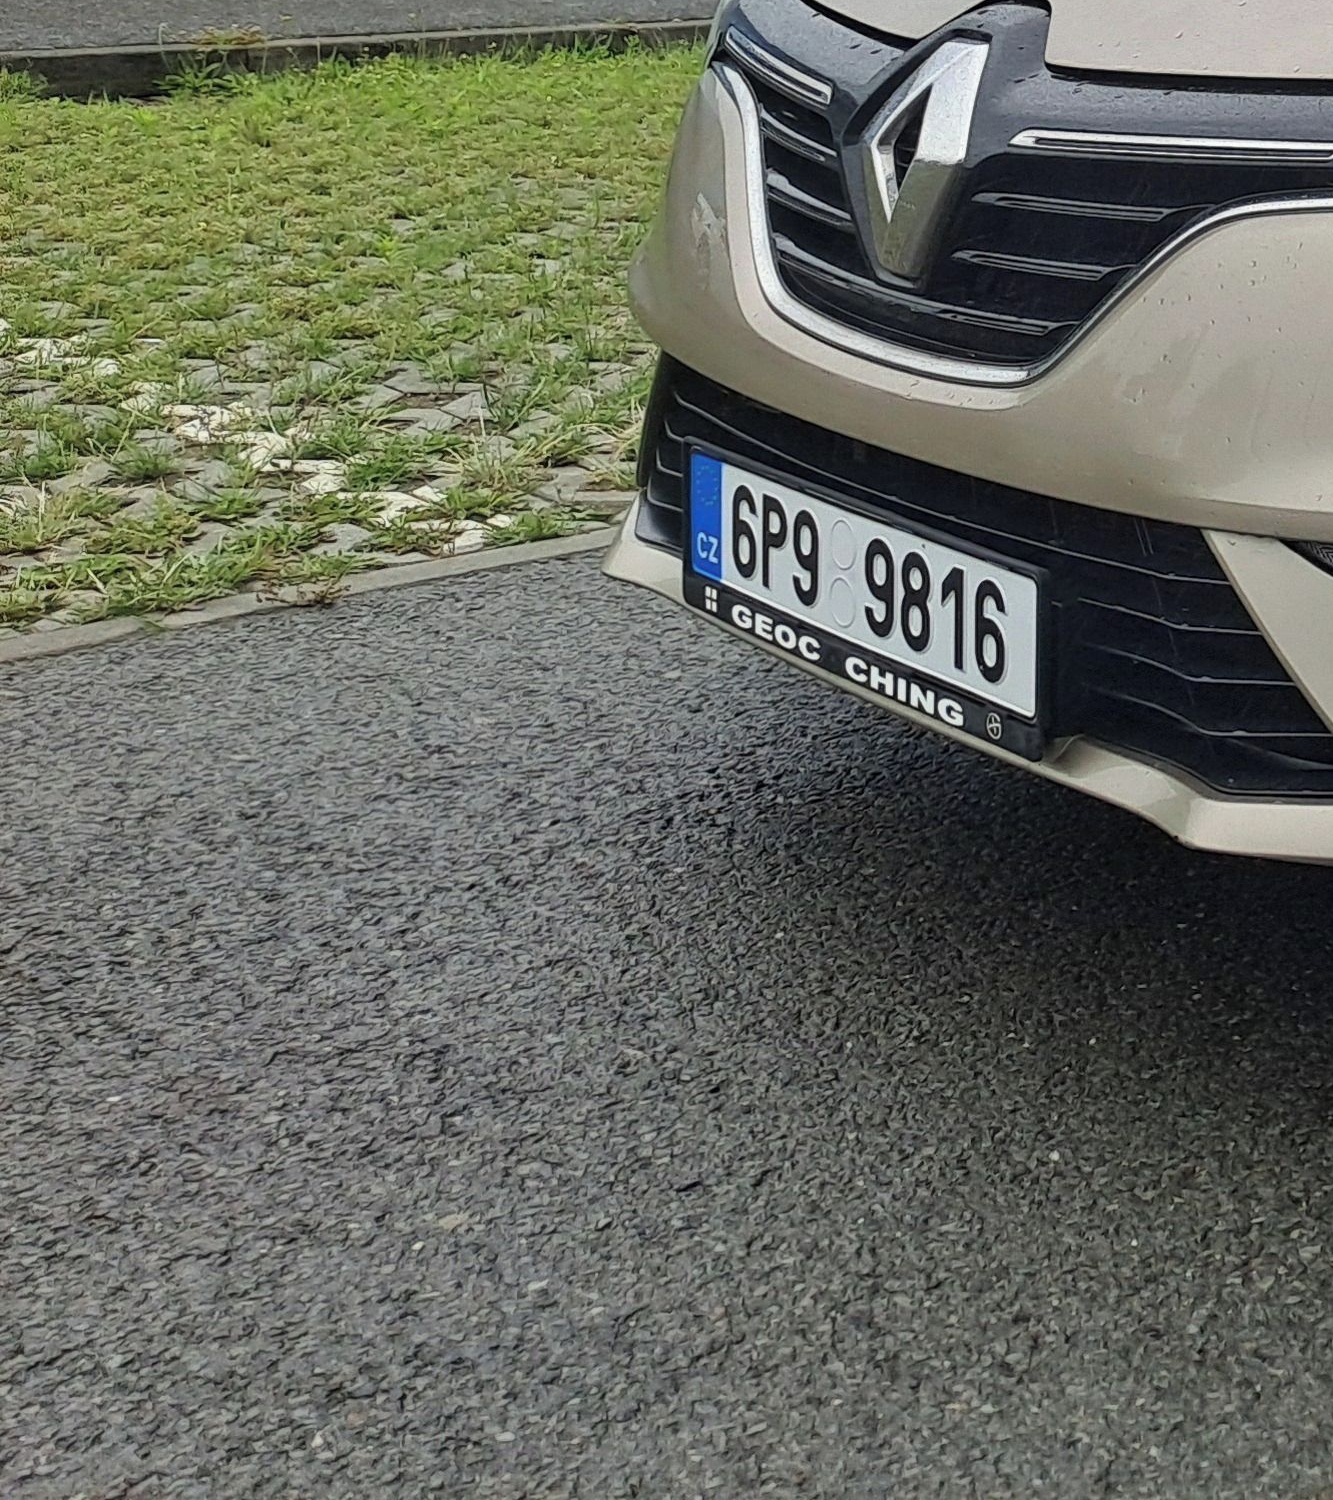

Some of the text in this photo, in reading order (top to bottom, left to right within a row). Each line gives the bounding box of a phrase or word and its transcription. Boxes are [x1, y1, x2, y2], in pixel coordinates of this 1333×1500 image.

[697, 532, 719, 565] CZ
[732, 484, 1008, 685] 6P9 9816
